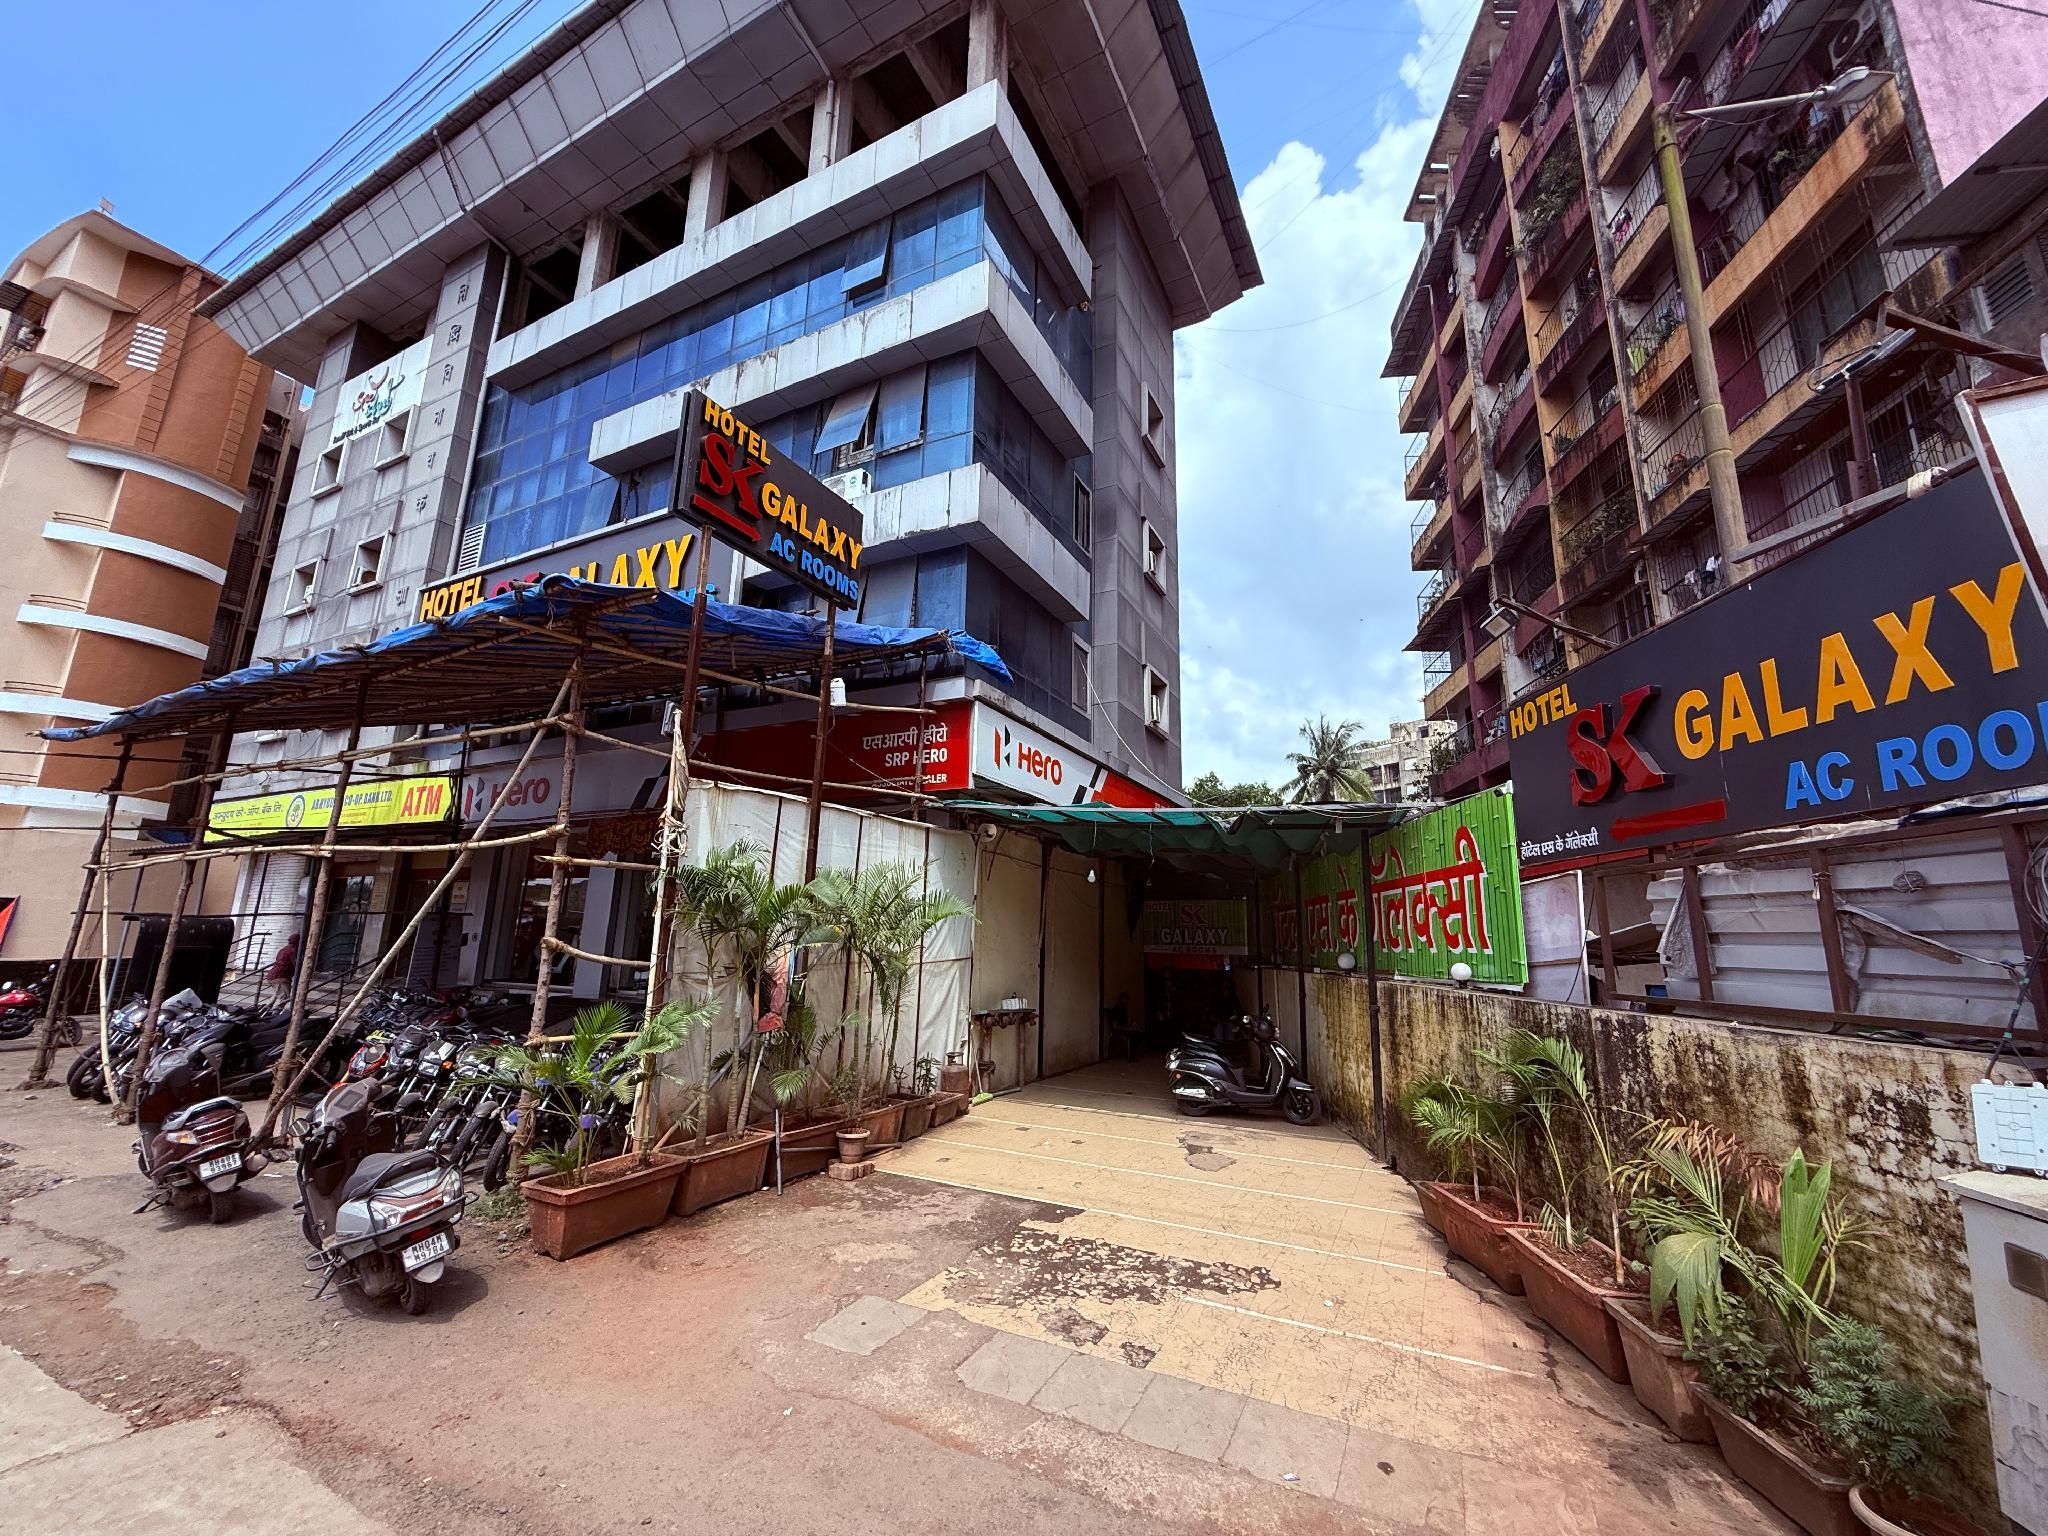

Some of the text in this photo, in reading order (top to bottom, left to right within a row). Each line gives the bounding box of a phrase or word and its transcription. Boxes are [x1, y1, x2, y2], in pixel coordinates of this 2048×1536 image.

[705, 398, 771, 464] HOTEL
[700, 433, 863, 570] SK GALAXY
[770, 532, 858, 601] AC ROOMS
[419, 576, 484, 622] HOTEL
[1674, 561, 2025, 760] GALAXY
[885, 748, 948, 767] SRP HERO
[1018, 742, 1063, 786] Hero
[1509, 683, 1666, 806] HOTEL SK
[1785, 700, 2048, 810] AC ROO
[400, 784, 444, 818] ATM
[490, 777, 550, 808] Hero
[1541, 841, 1555, 856] एस
[1555, 834, 1564, 852] के
[1180, 903, 1208, 926] SK
[1336, 863, 1359, 949] के
[1161, 927, 1228, 945] GALAXY
